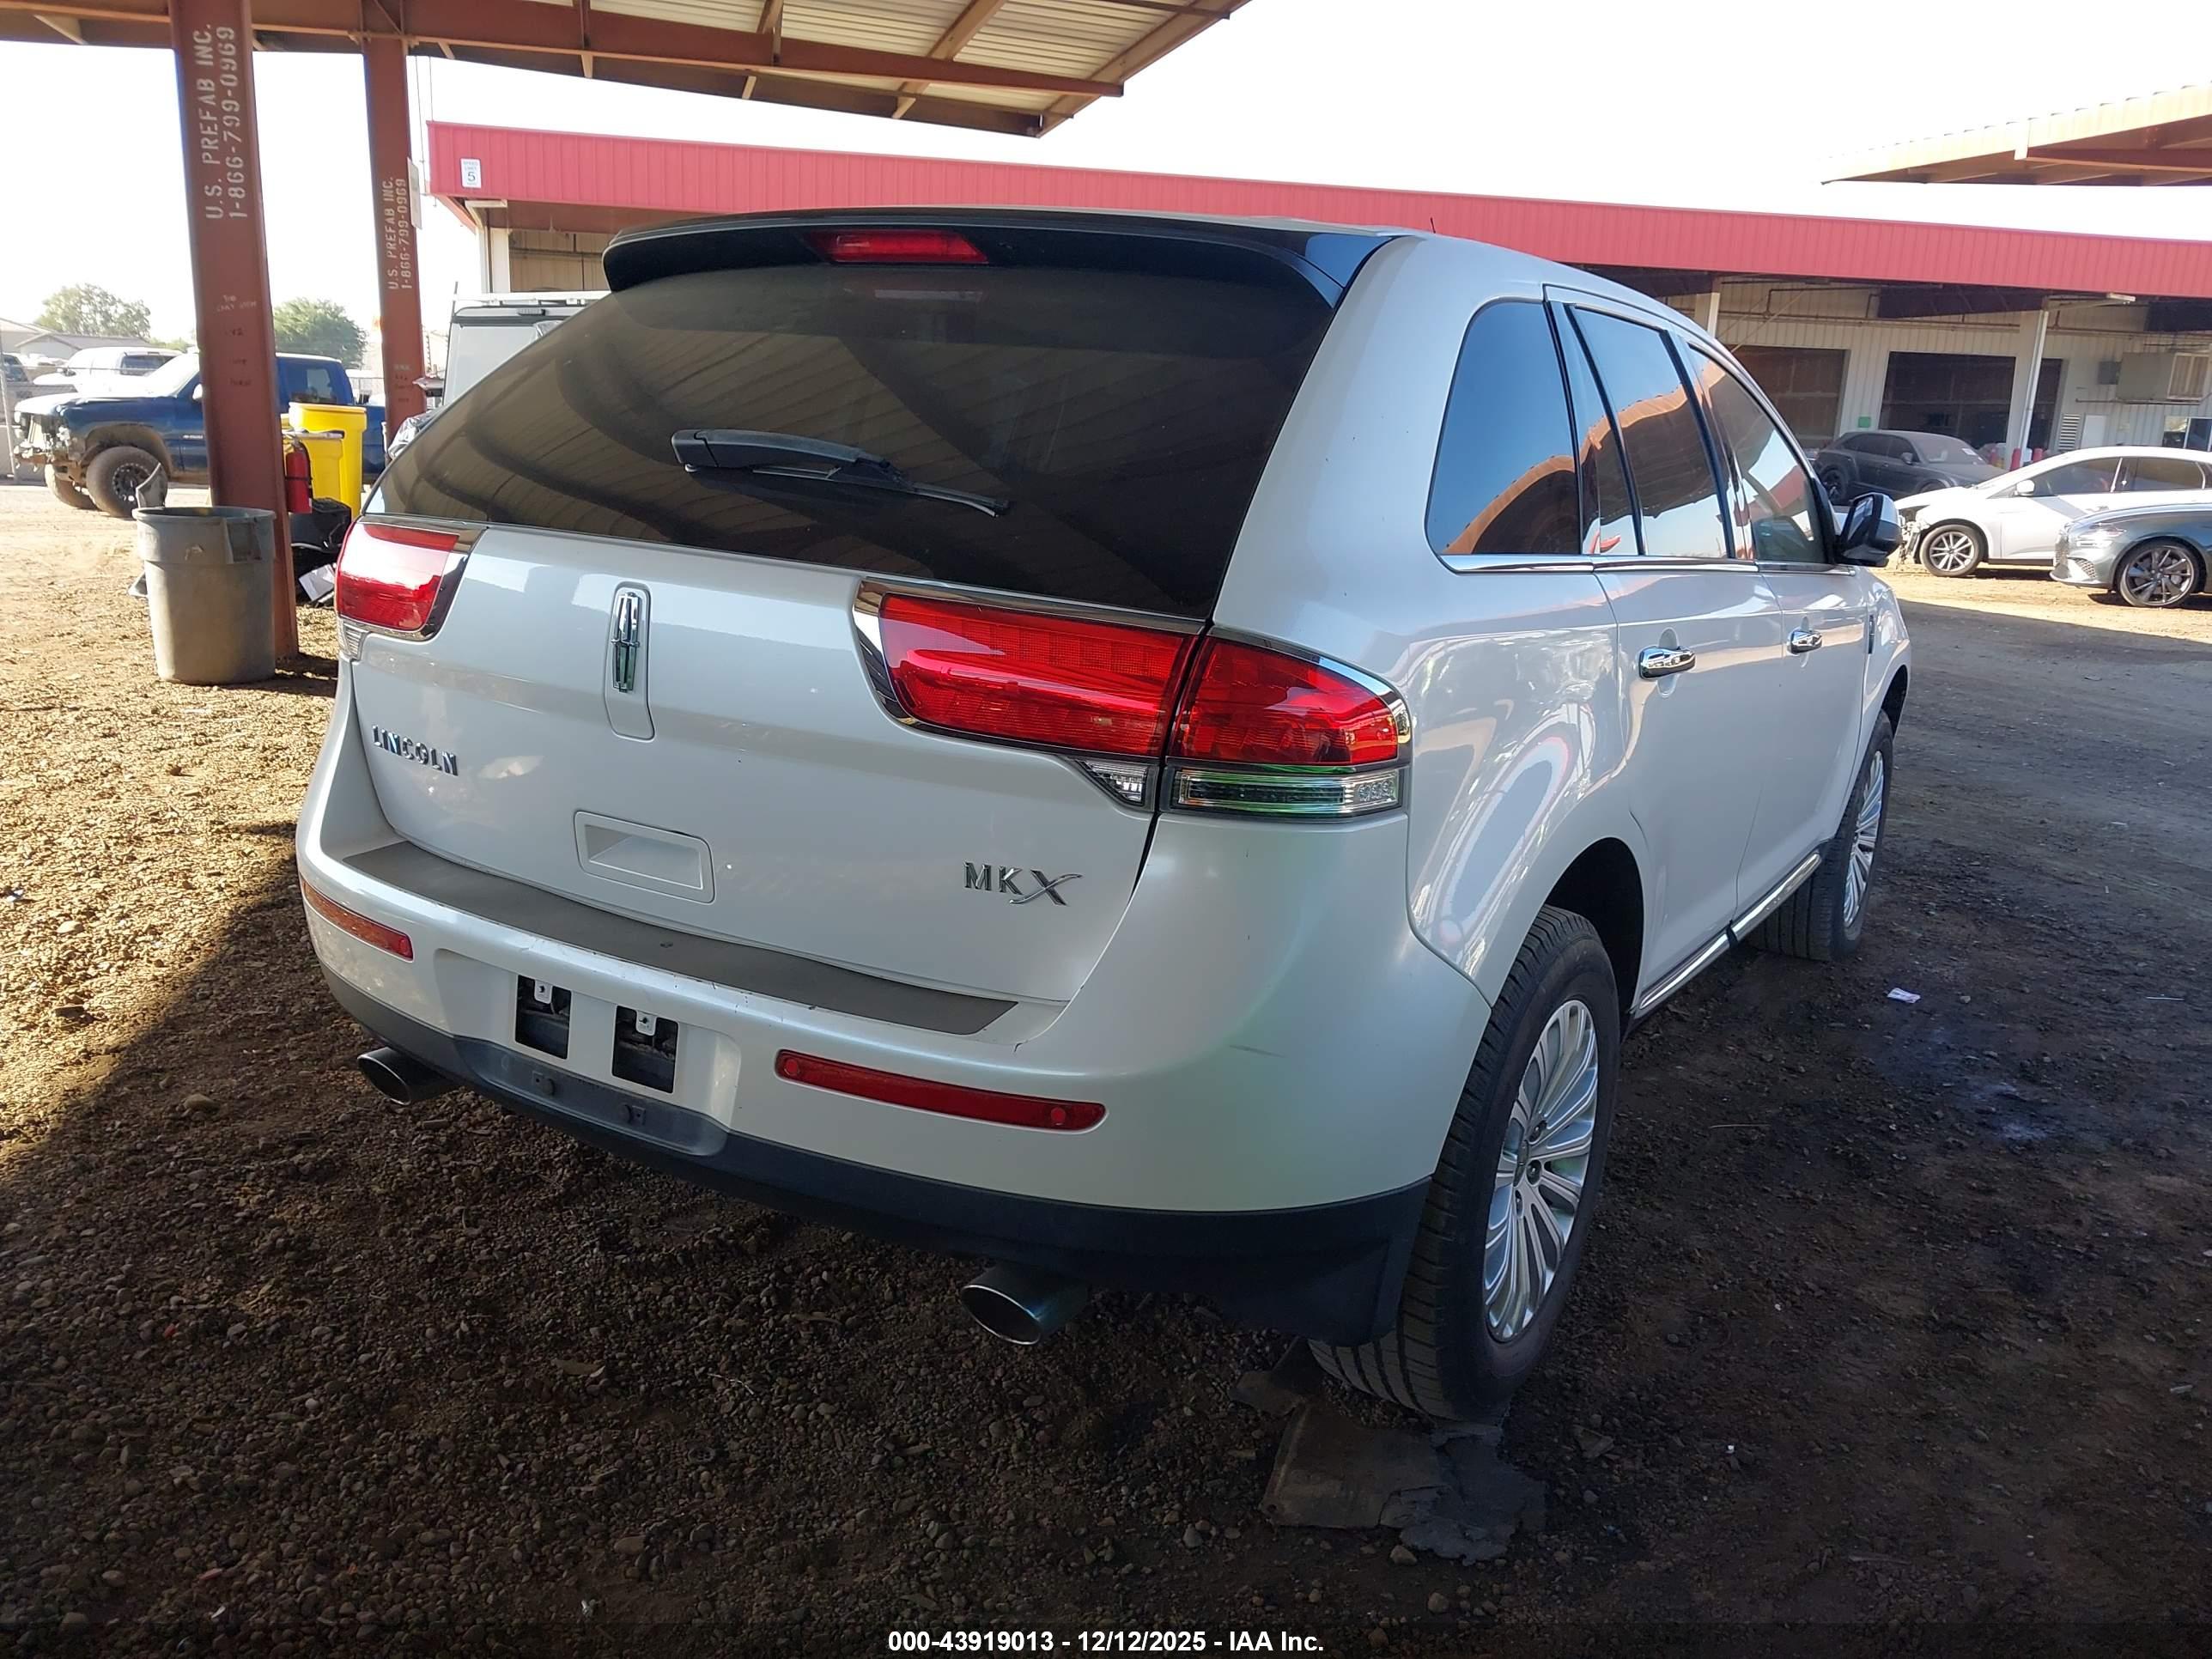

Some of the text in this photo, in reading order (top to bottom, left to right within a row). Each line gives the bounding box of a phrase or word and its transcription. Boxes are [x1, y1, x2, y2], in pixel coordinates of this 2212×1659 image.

[192, 23, 225, 220] U.S. PREFAB INC.
[216, 26, 248, 218] 1-866-799-0969
[468, 171, 476, 182] 5
[382, 176, 399, 290] U.S. PREFAB INC.
[372, 724, 459, 777] LINCOLN
[963, 860, 1084, 907] MKX
